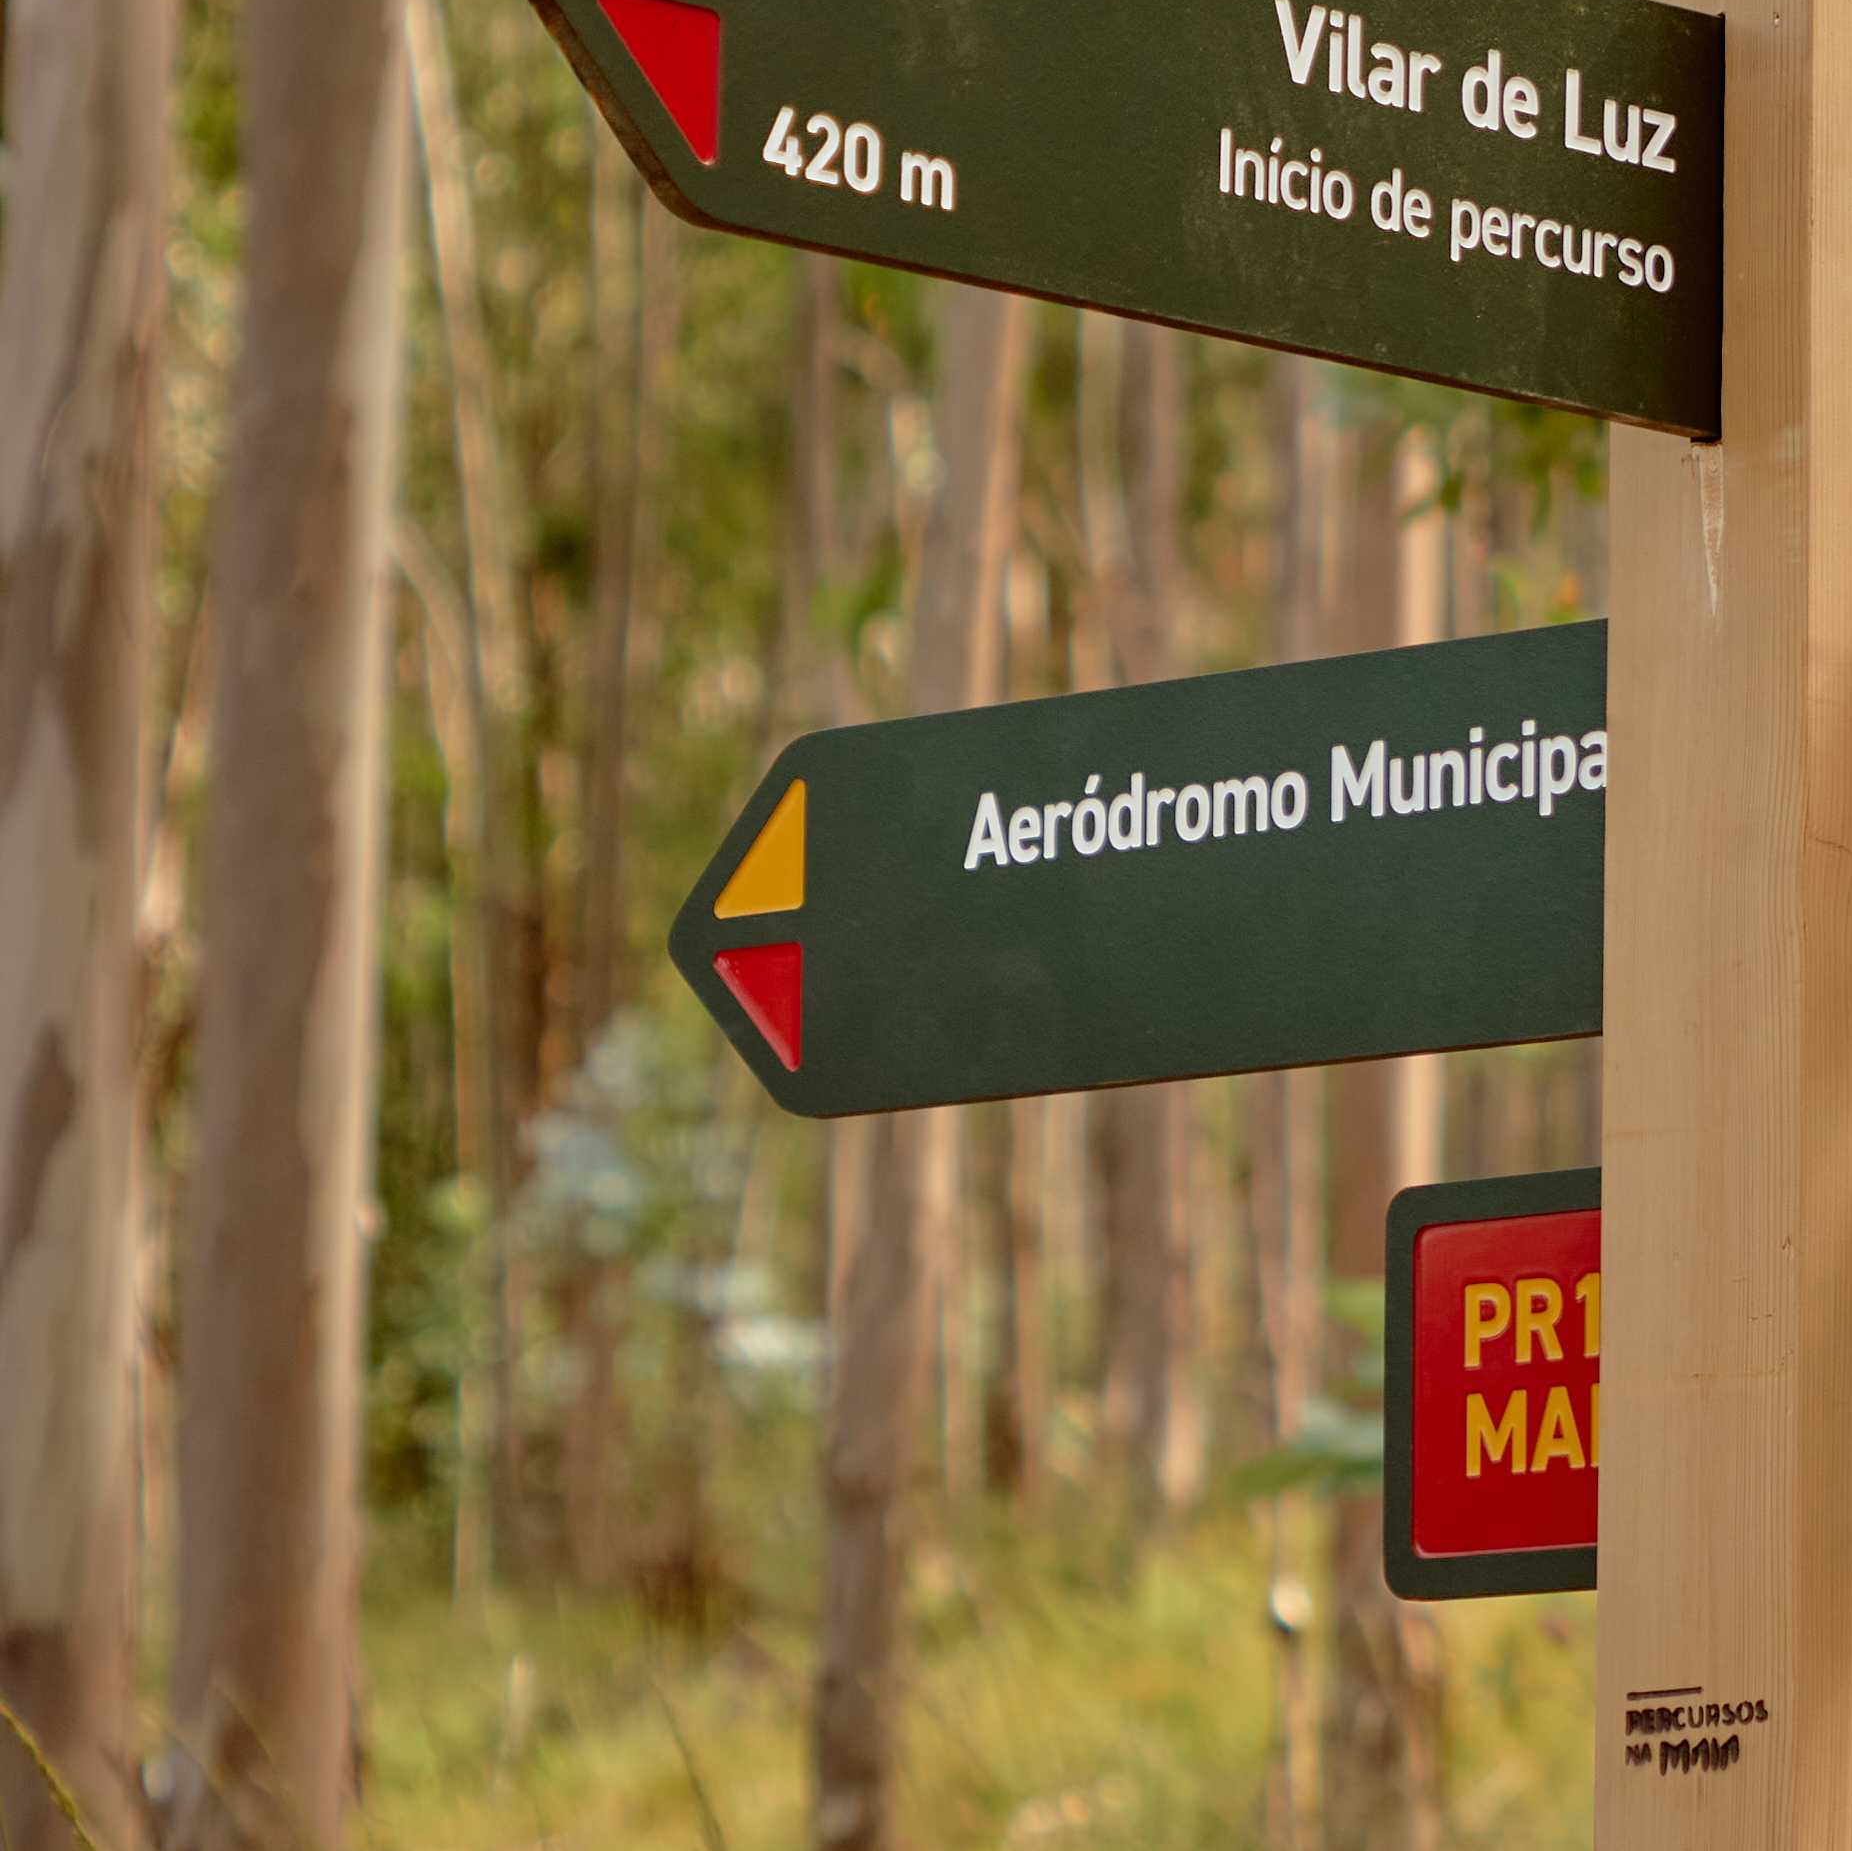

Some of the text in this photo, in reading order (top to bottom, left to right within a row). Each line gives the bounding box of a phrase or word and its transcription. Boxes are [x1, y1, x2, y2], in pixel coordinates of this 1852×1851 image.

[761, 104, 955, 213] 420 m
[1460, 47, 1542, 141] de
[1563, 67, 1677, 175] Luz
[1218, 126, 1676, 294] Início de percurso
[962, 718, 1607, 872] Aeródromo Municipa
[1466, 1382, 1601, 1478] MAI
[1625, 1699, 1769, 1736] PERCURSOS
[1625, 1734, 1740, 1776] NA MAIA
